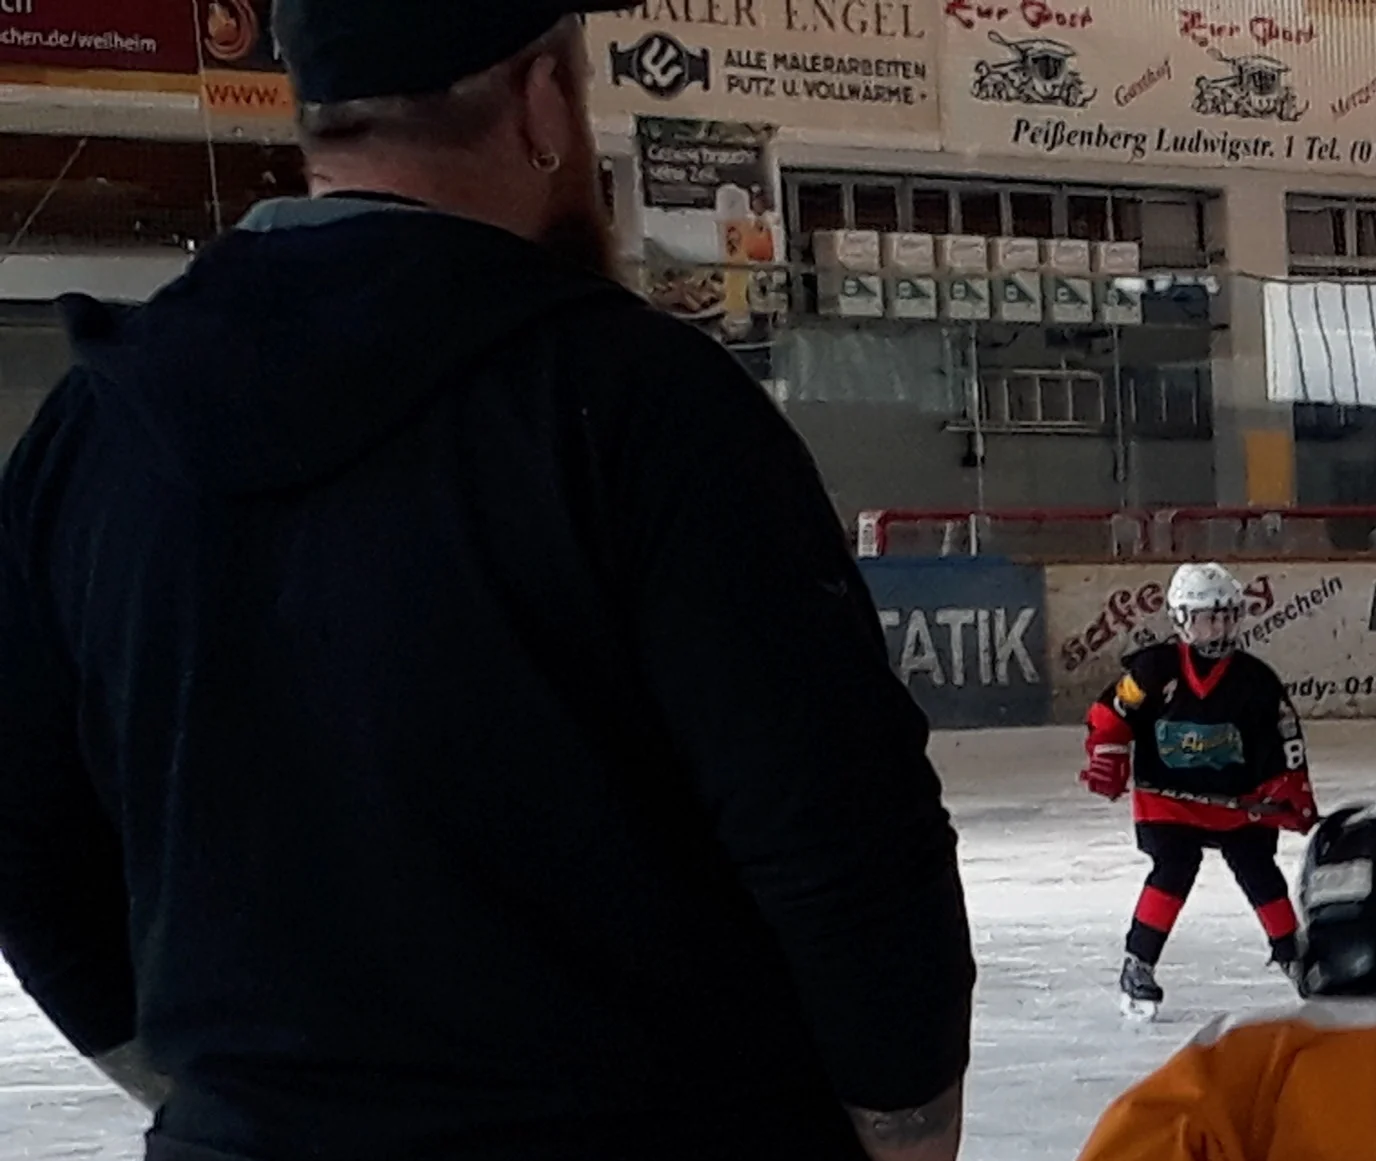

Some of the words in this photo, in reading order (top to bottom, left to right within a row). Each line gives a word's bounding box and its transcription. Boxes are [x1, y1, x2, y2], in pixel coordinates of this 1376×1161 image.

[725, 74, 775, 97] PUTZ
[1011, 118, 1148, 158] Peißenberg
[1154, 127, 1276, 162] Ludwigstr.
[1303, 136, 1343, 162] Tel.
